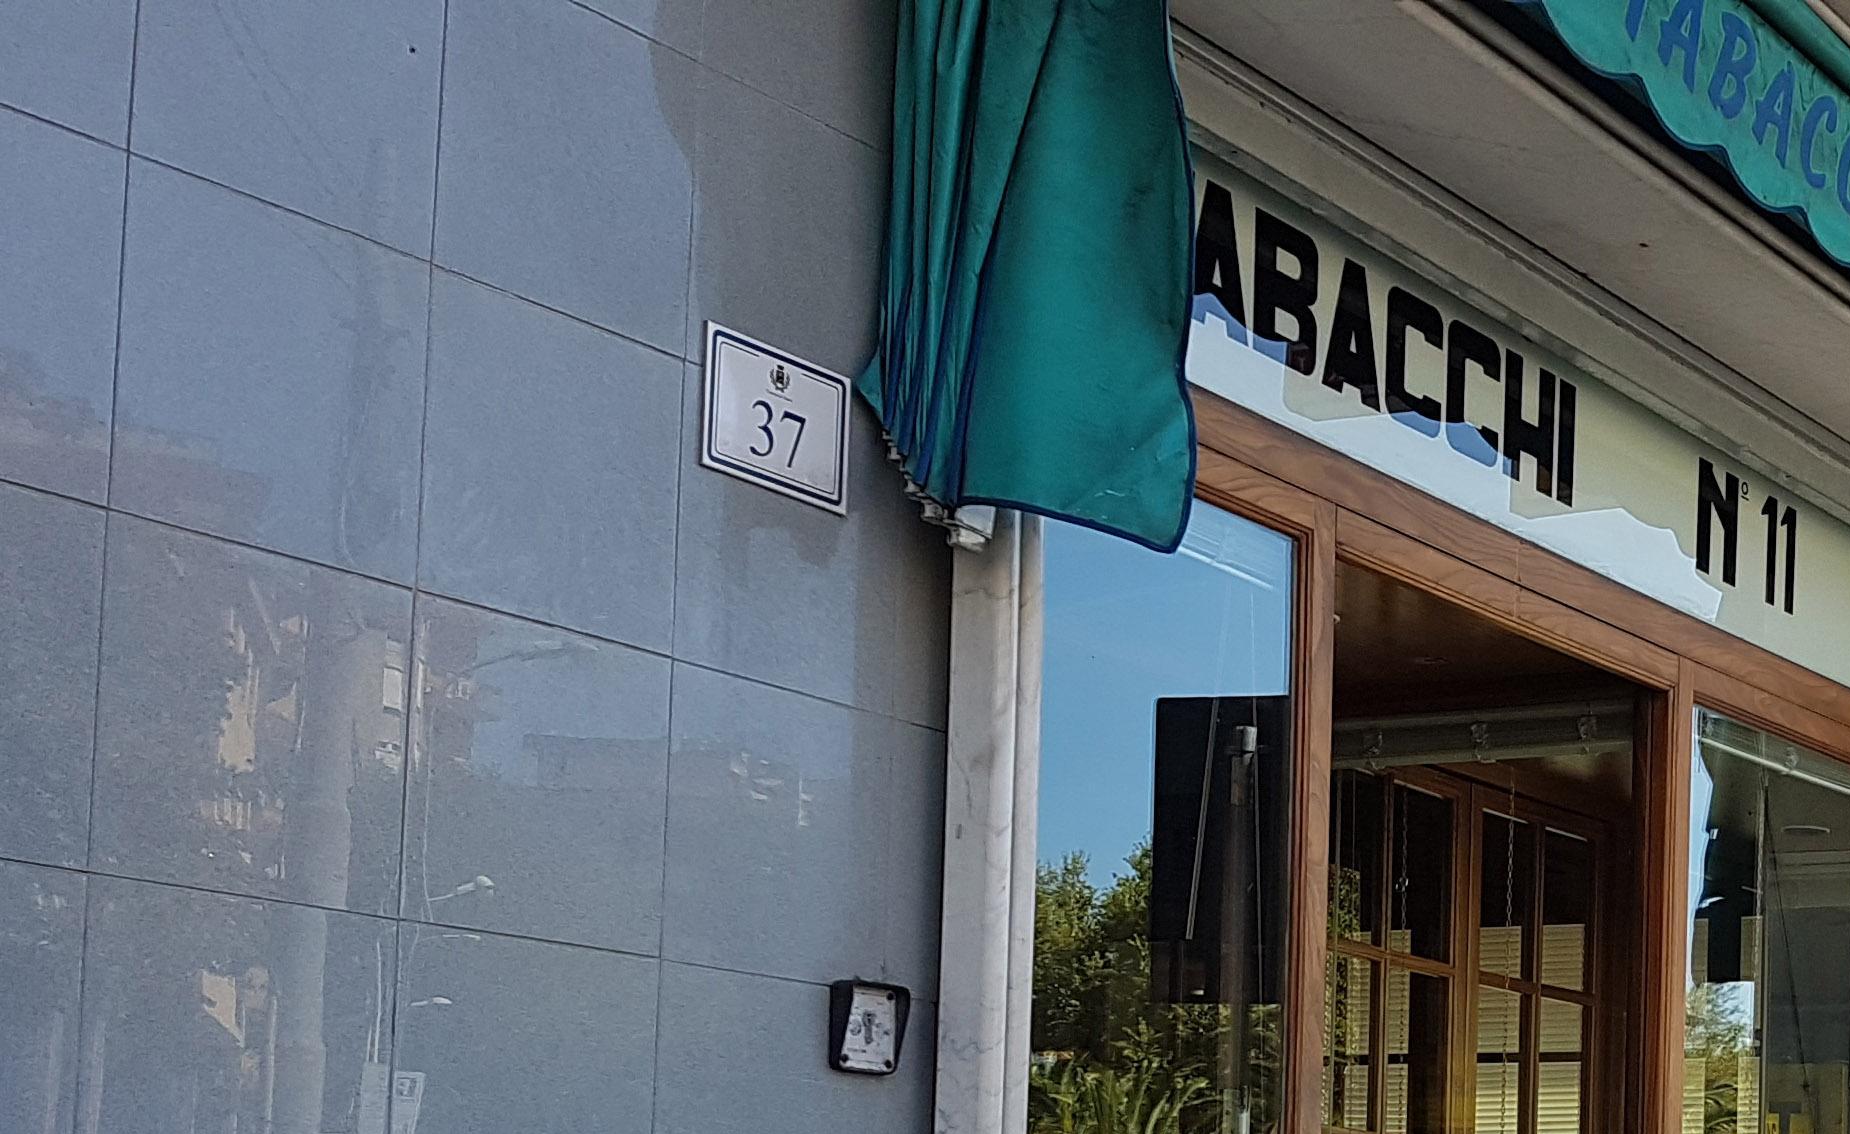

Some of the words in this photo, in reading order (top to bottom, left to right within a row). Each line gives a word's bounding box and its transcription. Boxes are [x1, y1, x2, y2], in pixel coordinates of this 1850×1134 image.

[749, 400, 806, 468] 37
[1193, 174, 1577, 508] ABACCHI
[1761, 495, 1797, 616] 11
